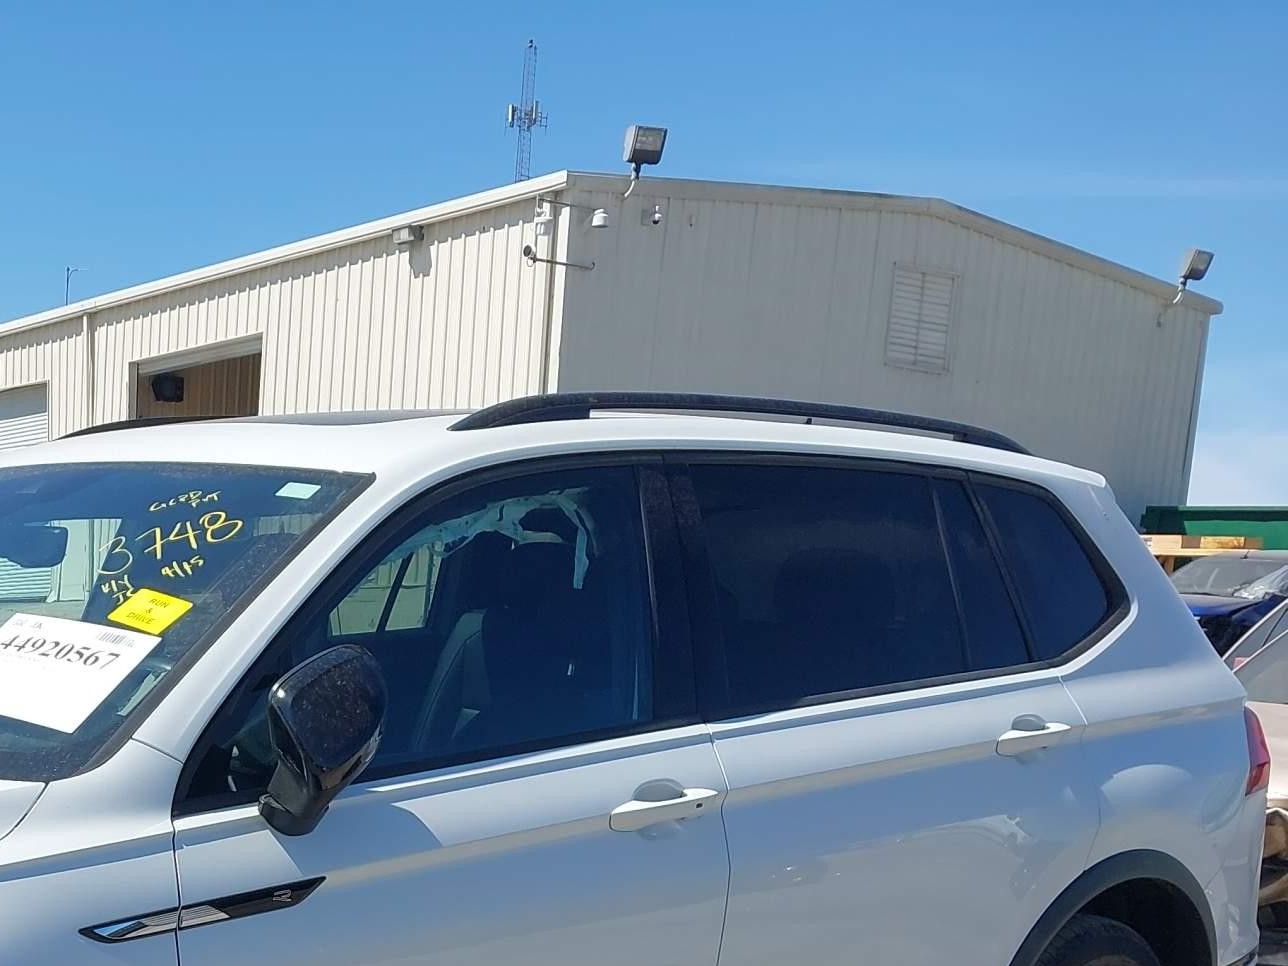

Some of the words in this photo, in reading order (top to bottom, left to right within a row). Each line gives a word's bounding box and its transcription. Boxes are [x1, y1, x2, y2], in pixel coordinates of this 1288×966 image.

[148, 598, 170, 609] RUN
[126, 611, 156, 625] DRIVE
[0, 634, 121, 669] 44920567
